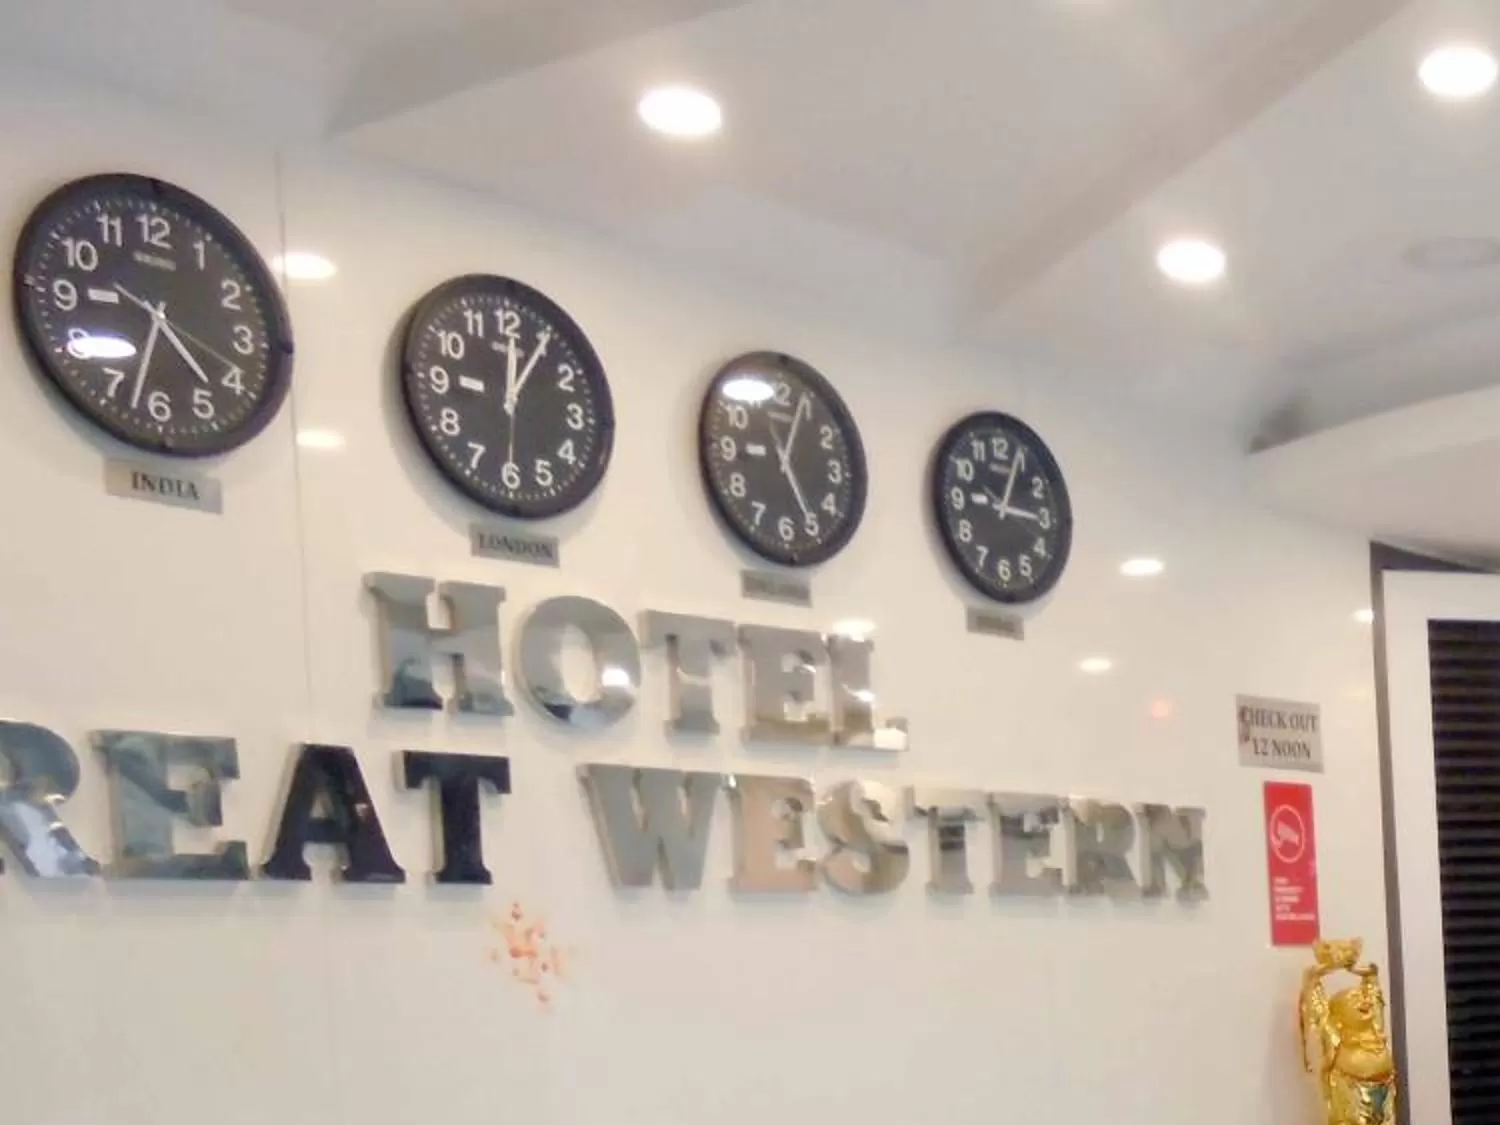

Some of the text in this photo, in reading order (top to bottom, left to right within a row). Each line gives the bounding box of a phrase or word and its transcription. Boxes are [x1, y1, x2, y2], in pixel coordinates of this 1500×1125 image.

[97, 213, 122, 247] 11
[137, 215, 172, 249] 12
[61, 238, 98, 271] 10
[193, 240, 206, 270] 1
[53, 280, 77, 310] 9
[221, 280, 241, 310] 2
[464, 309, 483, 337] 11
[494, 308, 520, 339] 12
[67, 328, 94, 359] 8
[233, 326, 253, 354] 3
[437, 330, 465, 360] 10
[102, 368, 124, 397] 7
[222, 366, 245, 394] 4
[429, 365, 449, 394] 9
[557, 364, 575, 392] 2
[148, 391, 172, 422] 6
[192, 389, 215, 420] 5
[567, 403, 585, 430] 3
[725, 404, 748, 429] 10
[440, 408, 461, 436] 8
[720, 436, 737, 461] 9
[820, 425, 833, 450] 2
[971, 440, 985, 462] 11
[991, 437, 1009, 461] 12
[467, 442, 486, 469] 7
[557, 439, 577, 465] 4
[501, 461, 521, 490] 6
[535, 459, 553, 486] 5
[828, 460, 842, 484] 3
[955, 458, 974, 482] 10
[131, 471, 200, 500] INDIA
[729, 473, 746, 497] 8
[950, 487, 965, 510] 9
[1032, 476, 1043, 498] 2
[752, 501, 766, 525] 7
[821, 493, 836, 516] 4
[778, 516, 795, 541] 6
[804, 512, 820, 536] 5
[958, 519, 972, 543] 8
[1039, 508, 1050, 529] 3
[479, 533, 554, 559] LONDON
[976, 546, 989, 567] 7
[1033, 538, 1046, 559] 4
[997, 559, 1011, 581] 6
[1019, 555, 1032, 577] 5
[362, 571, 909, 750] HOTEL
[1240, 706, 1318, 732] CHECK OUT
[1252, 738, 1310, 759] 12 NOON
[577, 763, 1208, 900] WESTERN
